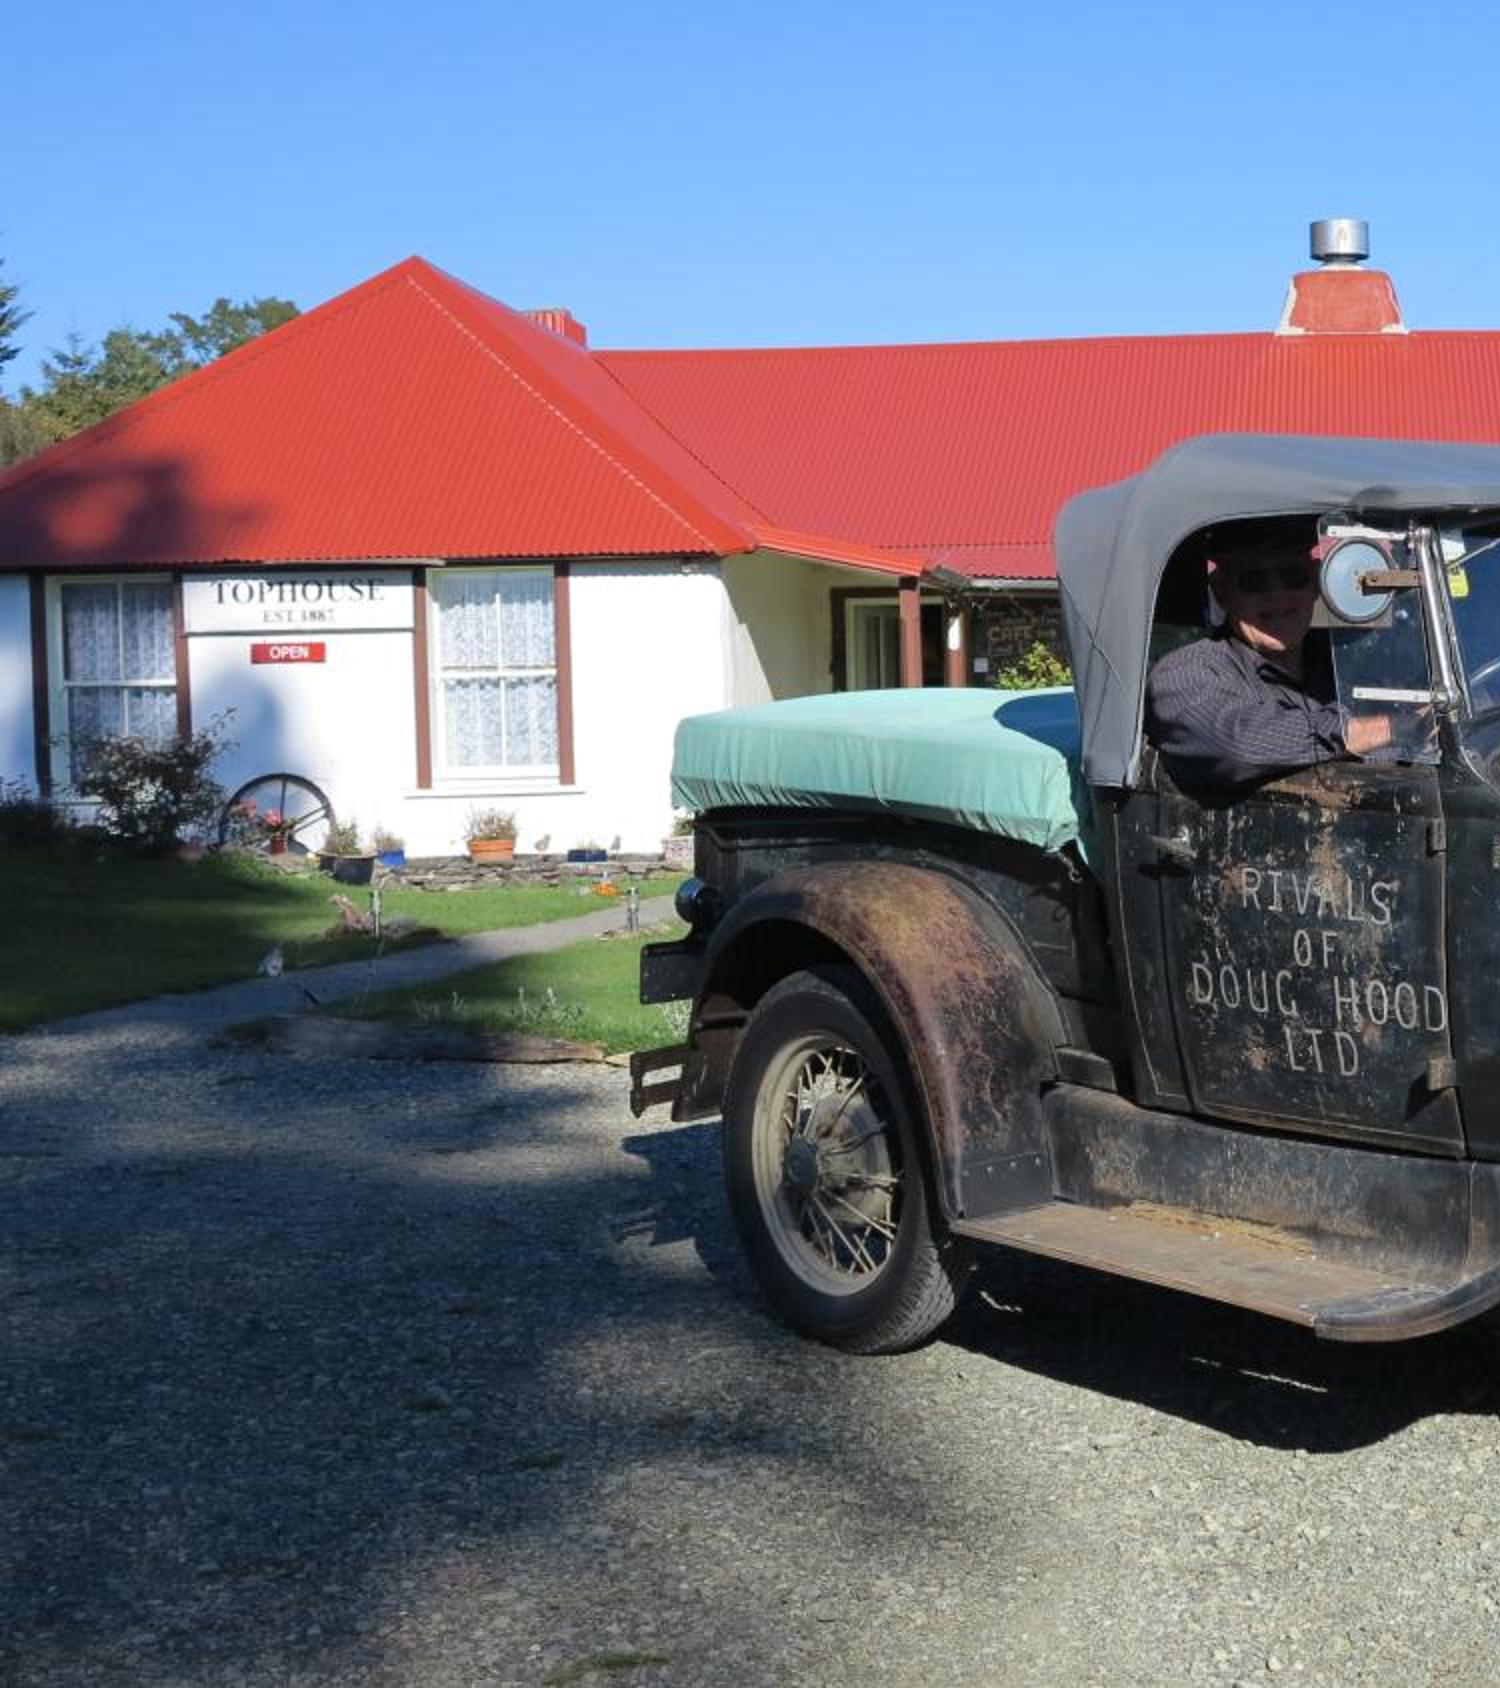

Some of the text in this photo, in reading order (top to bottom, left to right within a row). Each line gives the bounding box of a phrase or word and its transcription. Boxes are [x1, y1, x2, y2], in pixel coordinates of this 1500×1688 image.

[211, 577, 385, 604] TOPHOUSE
[269, 645, 310, 660] OPEN
[1241, 867, 1392, 925] RIVALS
[1293, 929, 1339, 968] OF
[1191, 962, 1447, 1032] DOUG HOOD
[1283, 1027, 1359, 1077] LTD
